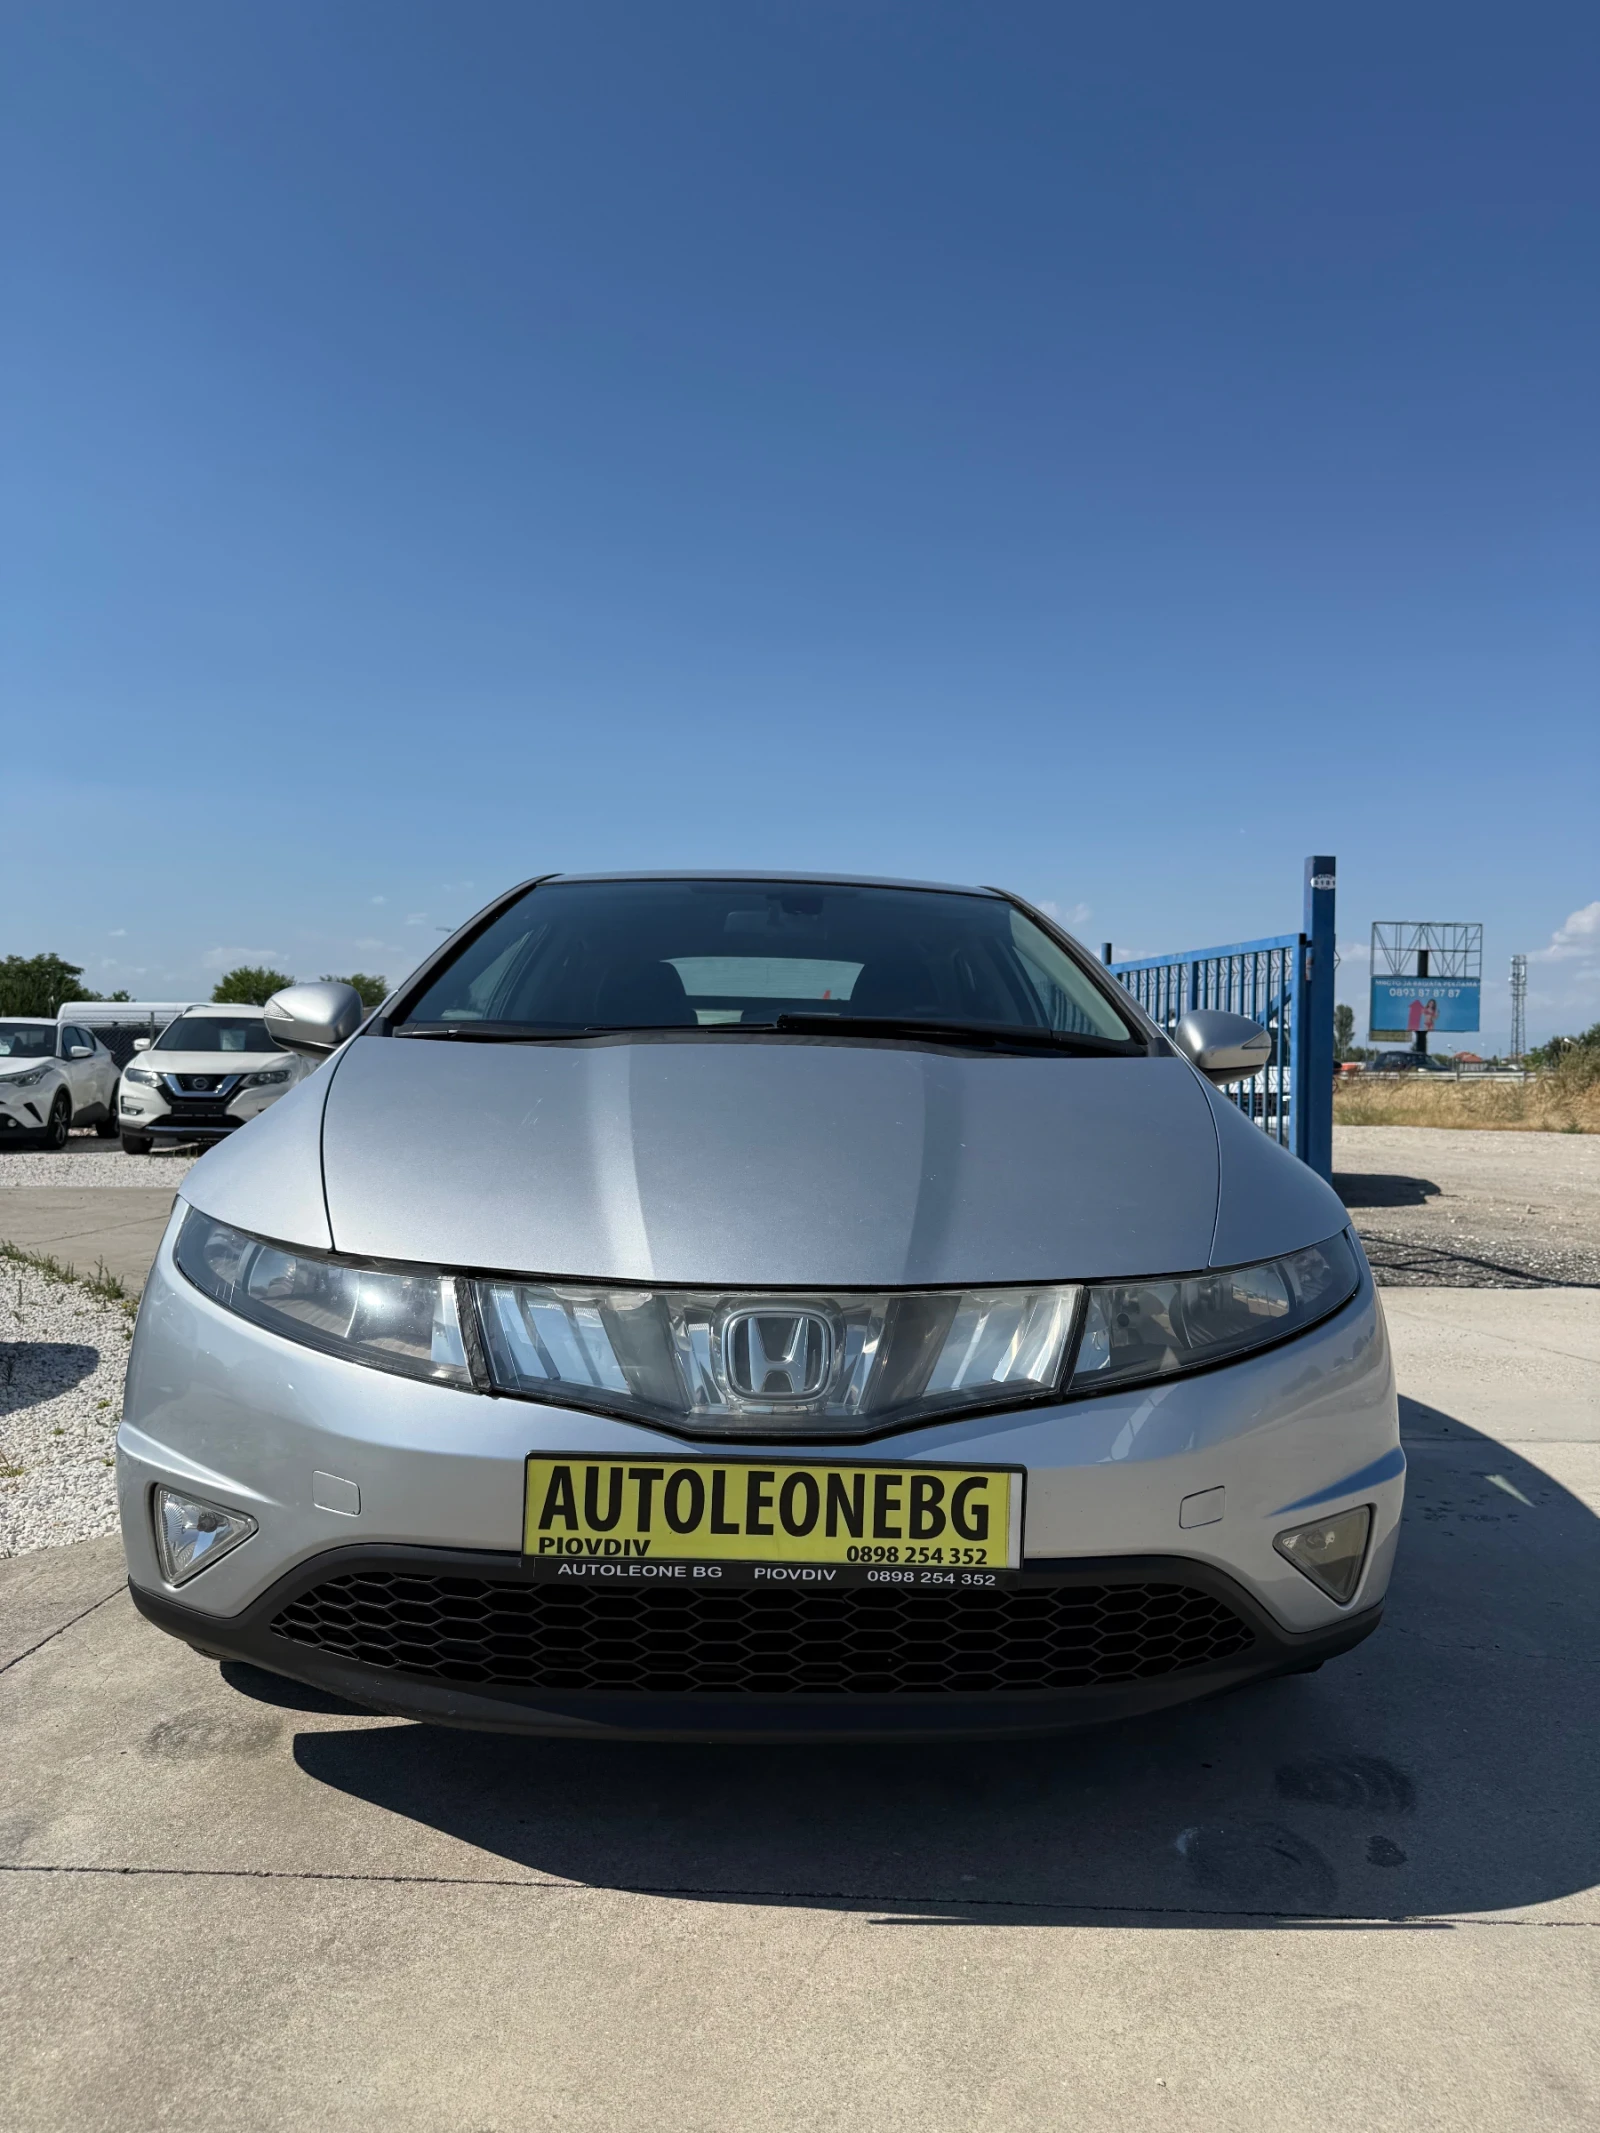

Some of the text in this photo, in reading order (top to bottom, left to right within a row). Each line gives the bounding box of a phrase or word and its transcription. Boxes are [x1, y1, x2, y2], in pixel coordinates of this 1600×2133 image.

[1389, 988, 1461, 998] 0893 87 87 87
[538, 1465, 989, 1541] AUTOLEONEBG
[538, 1537, 651, 1556] PIOVDIV
[846, 1545, 988, 1565] 0898 254 352
[557, 1563, 723, 1578] AUTOLEONE BG
[753, 1567, 837, 1581] PIOVDIV
[867, 1570, 996, 1586] 0898 254 352
